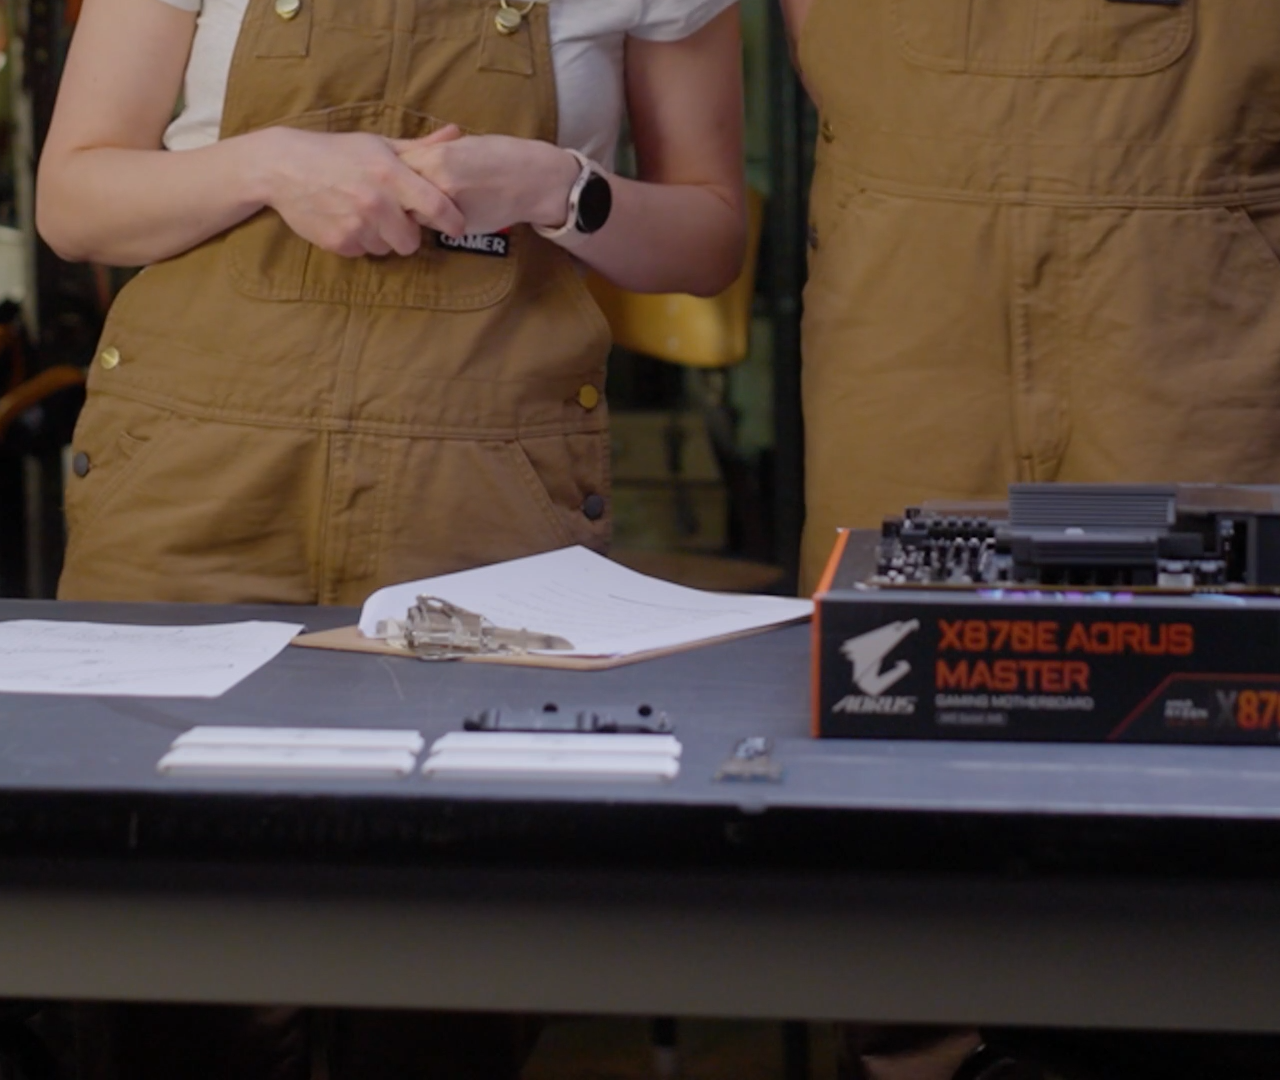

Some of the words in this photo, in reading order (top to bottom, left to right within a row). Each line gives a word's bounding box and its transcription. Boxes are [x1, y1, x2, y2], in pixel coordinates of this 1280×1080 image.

[936, 619, 1058, 652] X870E
[1066, 622, 1195, 655] AORUS
[935, 659, 1091, 692] MASTER
[831, 695, 918, 714] AORUS
[935, 693, 989, 709] GAMING
[991, 695, 1095, 711] MOTHERBOARD
